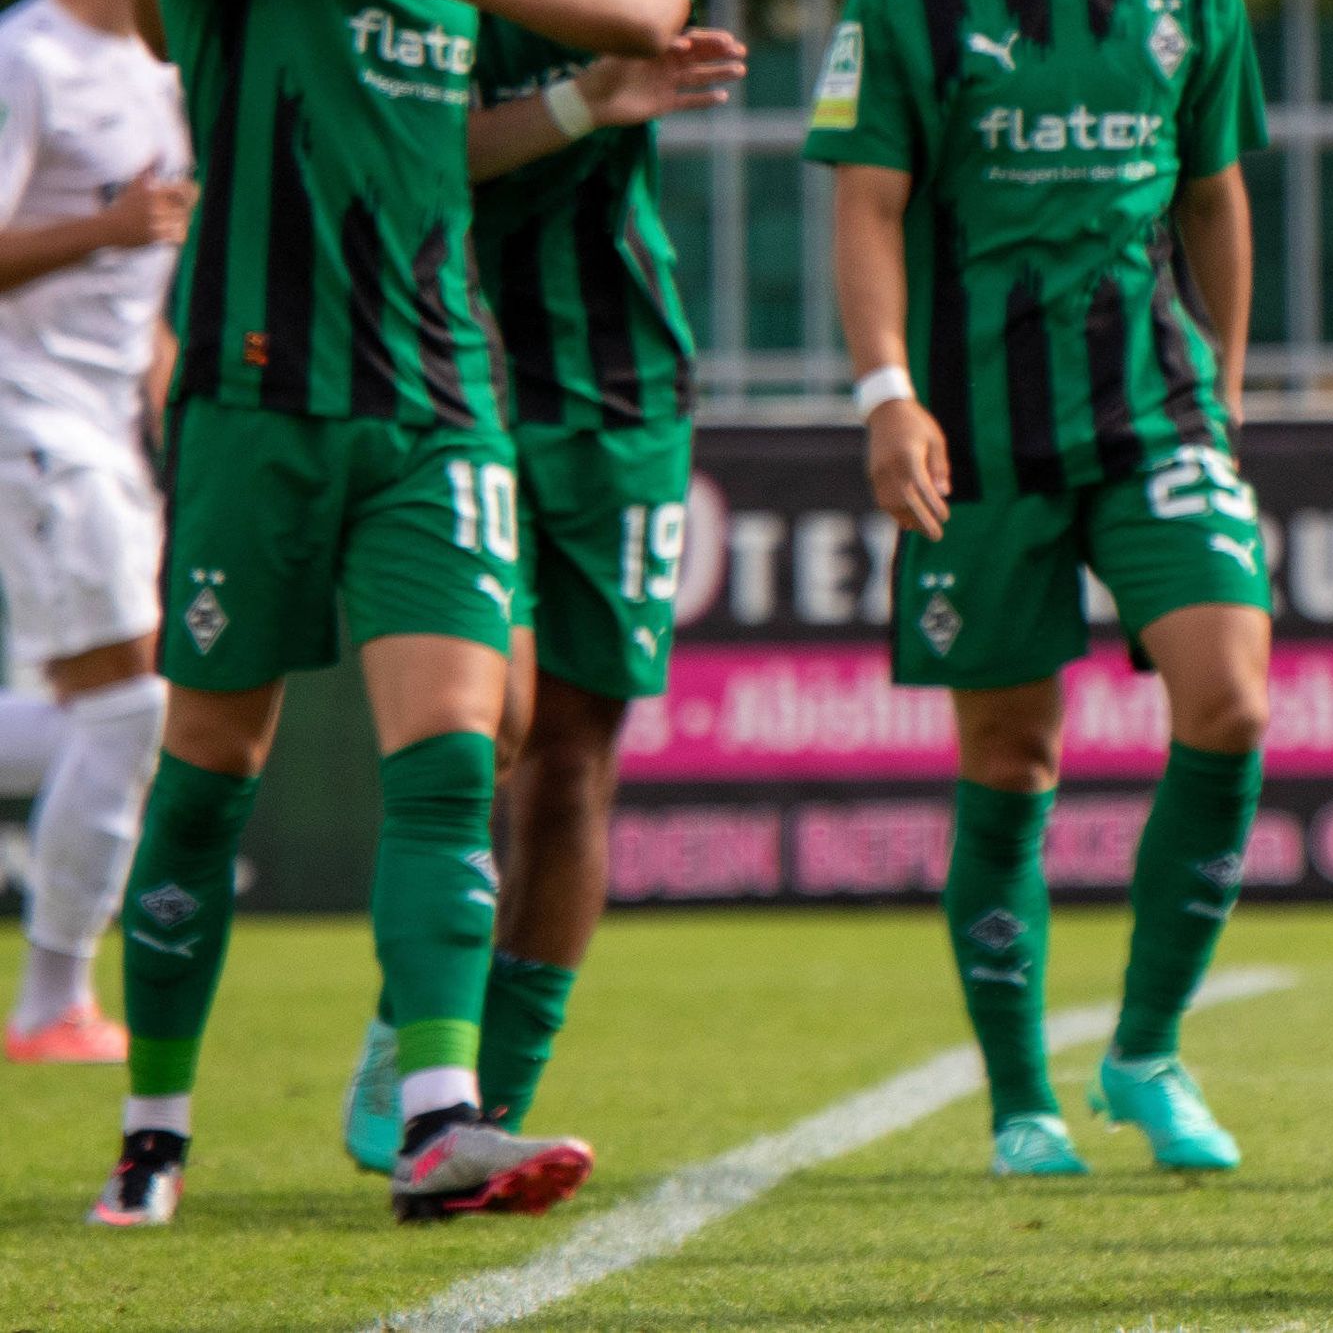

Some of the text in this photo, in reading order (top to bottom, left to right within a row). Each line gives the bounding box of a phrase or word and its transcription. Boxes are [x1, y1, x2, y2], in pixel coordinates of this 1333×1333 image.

[978, 104, 1163, 153] flatex
[447, 460, 518, 562] 10
[1148, 443, 1257, 521] 25
[622, 503, 687, 603] 19
